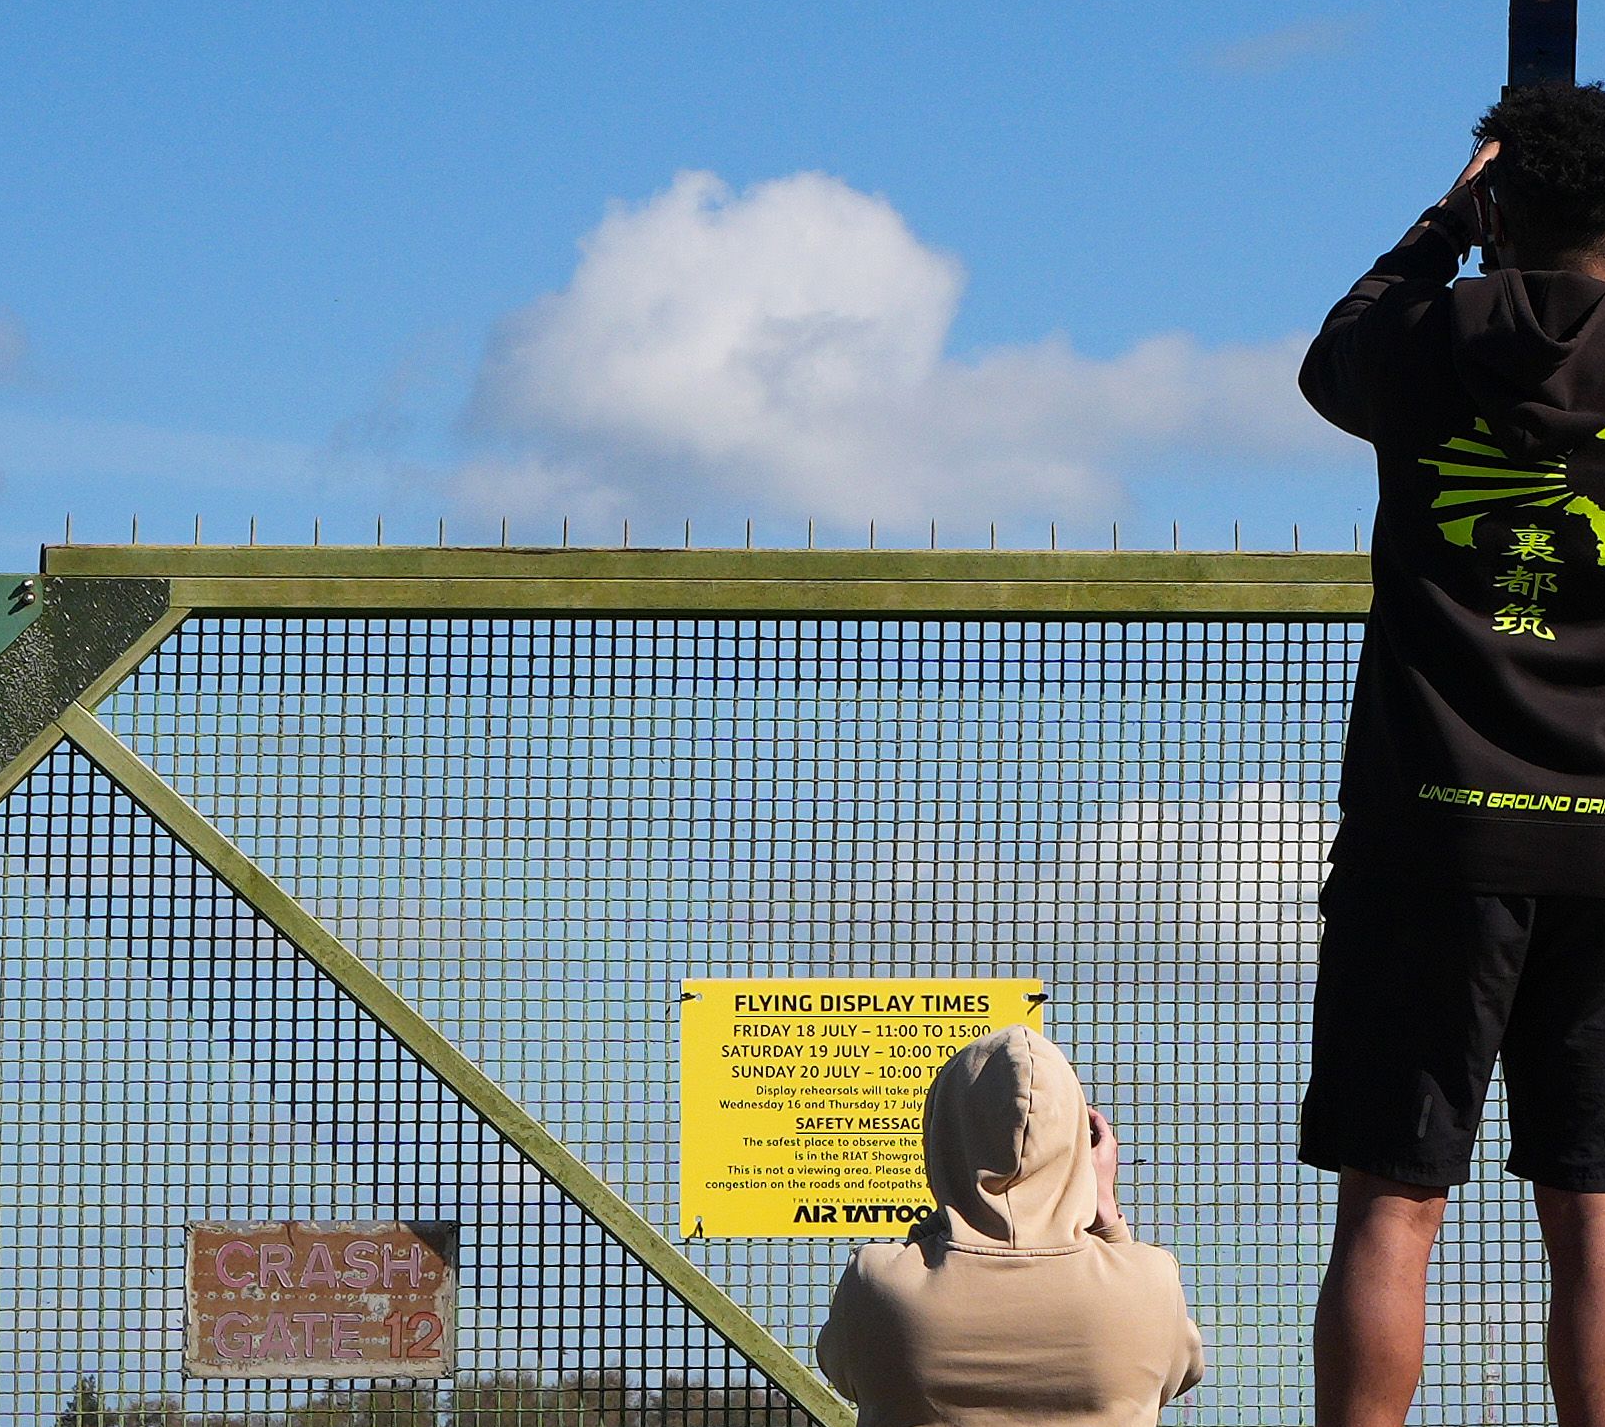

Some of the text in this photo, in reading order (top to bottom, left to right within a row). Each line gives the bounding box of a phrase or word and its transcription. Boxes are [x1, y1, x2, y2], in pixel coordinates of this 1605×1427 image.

[1419, 783, 1485, 807] UNDER
[1486, 790, 1573, 814] GROUND
[735, 995, 990, 1012] FLYING DISPLAY TIMES
[734, 1025, 791, 1037] FRIDAY
[797, 1025, 815, 1037] 18
[821, 1025, 857, 1037] JULY
[877, 1025, 918, 1037] 11:00
[923, 1025, 943, 1037] TO
[949, 1025, 991, 1037] 15:00
[721, 1045, 803, 1058] SATURDAY
[809, 1045, 828, 1058] 19
[833, 1045, 870, 1058] JULY
[889, 1045, 931, 1058] 10:00
[937, 1045, 956, 1058] TO
[732, 1066, 795, 1078] SUNDAY
[800, 1066, 819, 1078] 20
[823, 1066, 860, 1078] JULY
[879, 1066, 921, 1078] 10:00
[757, 1086, 929, 1097] Display rehearsals will take pla
[720, 1100, 922, 1111] Wednesday 16 and Thursday 17 July
[796, 1118, 923, 1129] SAFETY MESSAG
[743, 1137, 917, 1148] The safest place to observe the
[795, 1152, 925, 1163] is in the RIAT Showgrou
[728, 1166, 749, 1175] This
[754, 1166, 762, 1175] is
[766, 1166, 783, 1175] not
[797, 1166, 841, 1177] viewing
[844, 1166, 871, 1175] area.
[876, 1166, 911, 1175] Please
[706, 1180, 766, 1191] congestion
[788, 1180, 805, 1189] the
[810, 1180, 840, 1189] roads
[844, 1180, 864, 1189] and
[868, 1180, 922, 1191] footpaths
[793, 1205, 933, 1223] AIR TATTOO
[215, 1241, 421, 1288] CRASH
[212, 1310, 443, 1359] GATE 12
